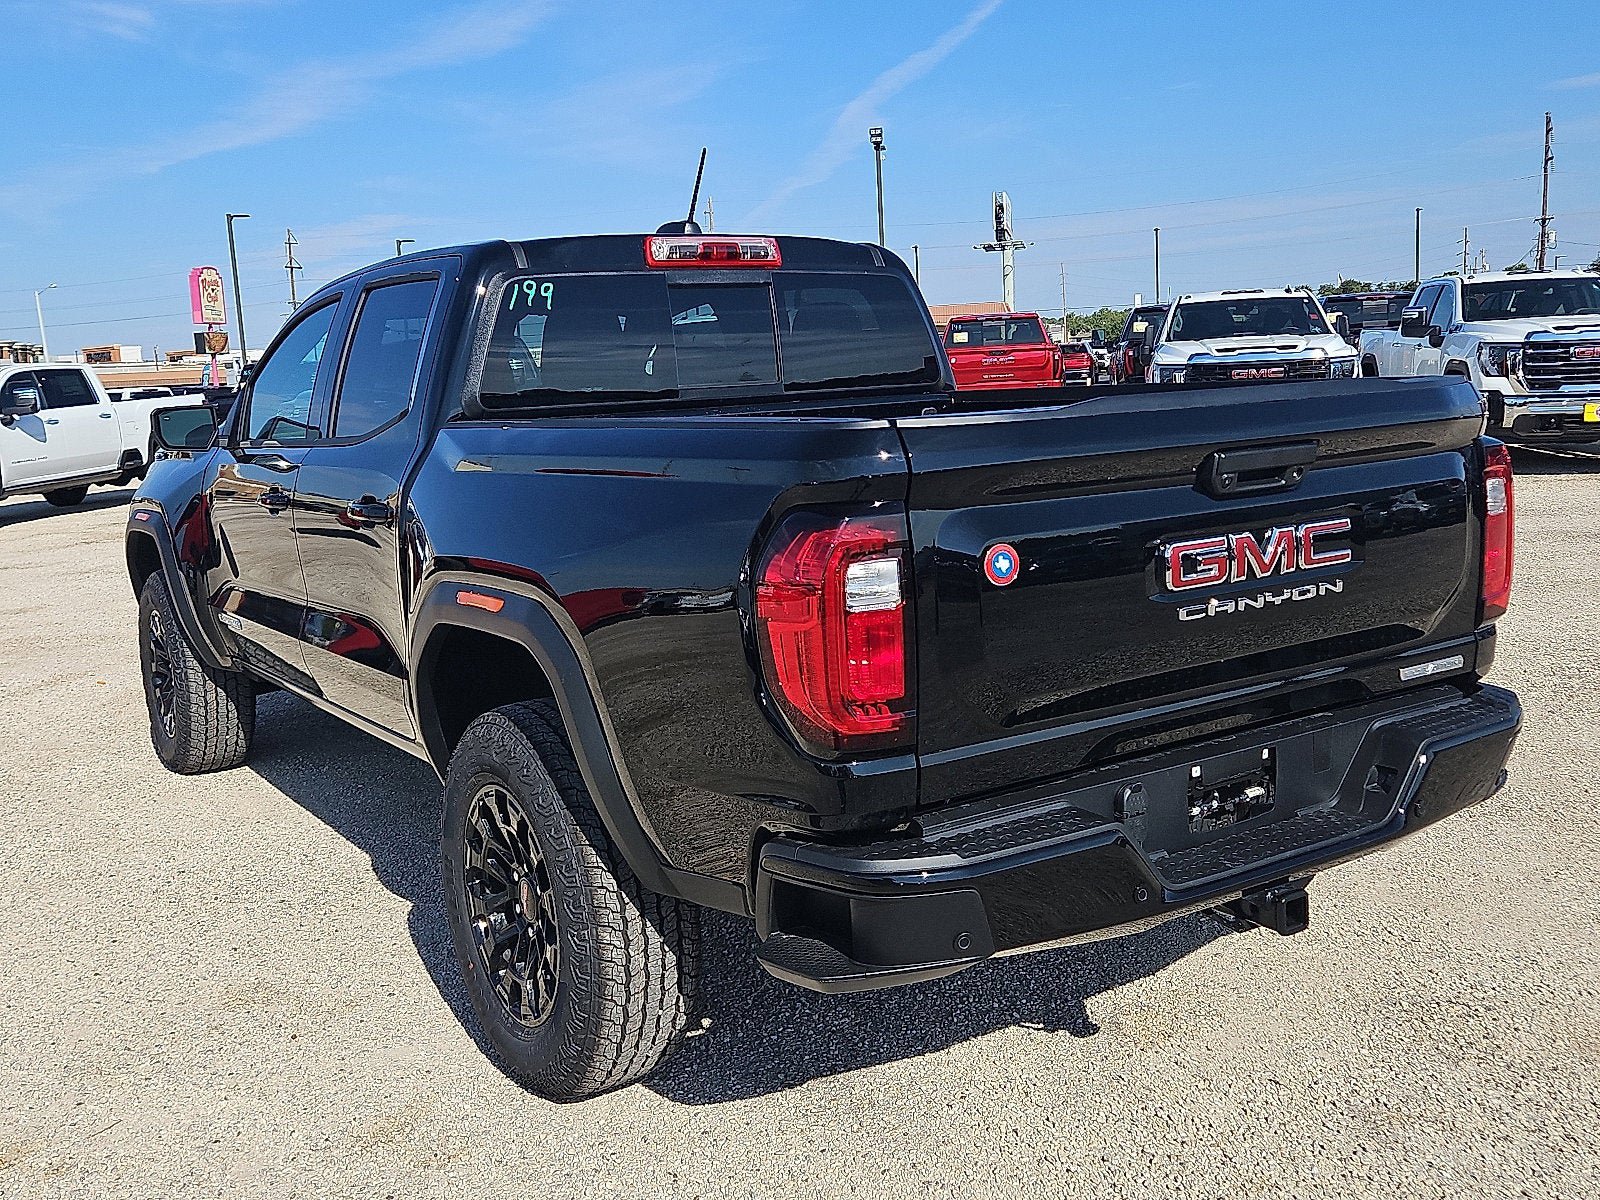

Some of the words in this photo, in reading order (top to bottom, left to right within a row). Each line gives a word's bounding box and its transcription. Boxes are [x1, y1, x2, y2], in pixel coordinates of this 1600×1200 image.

[509, 280, 554, 310] 199
[1231, 367, 1285, 379] GMC
[1165, 518, 1351, 592] GMC
[1177, 579, 1344, 621] CANYON
